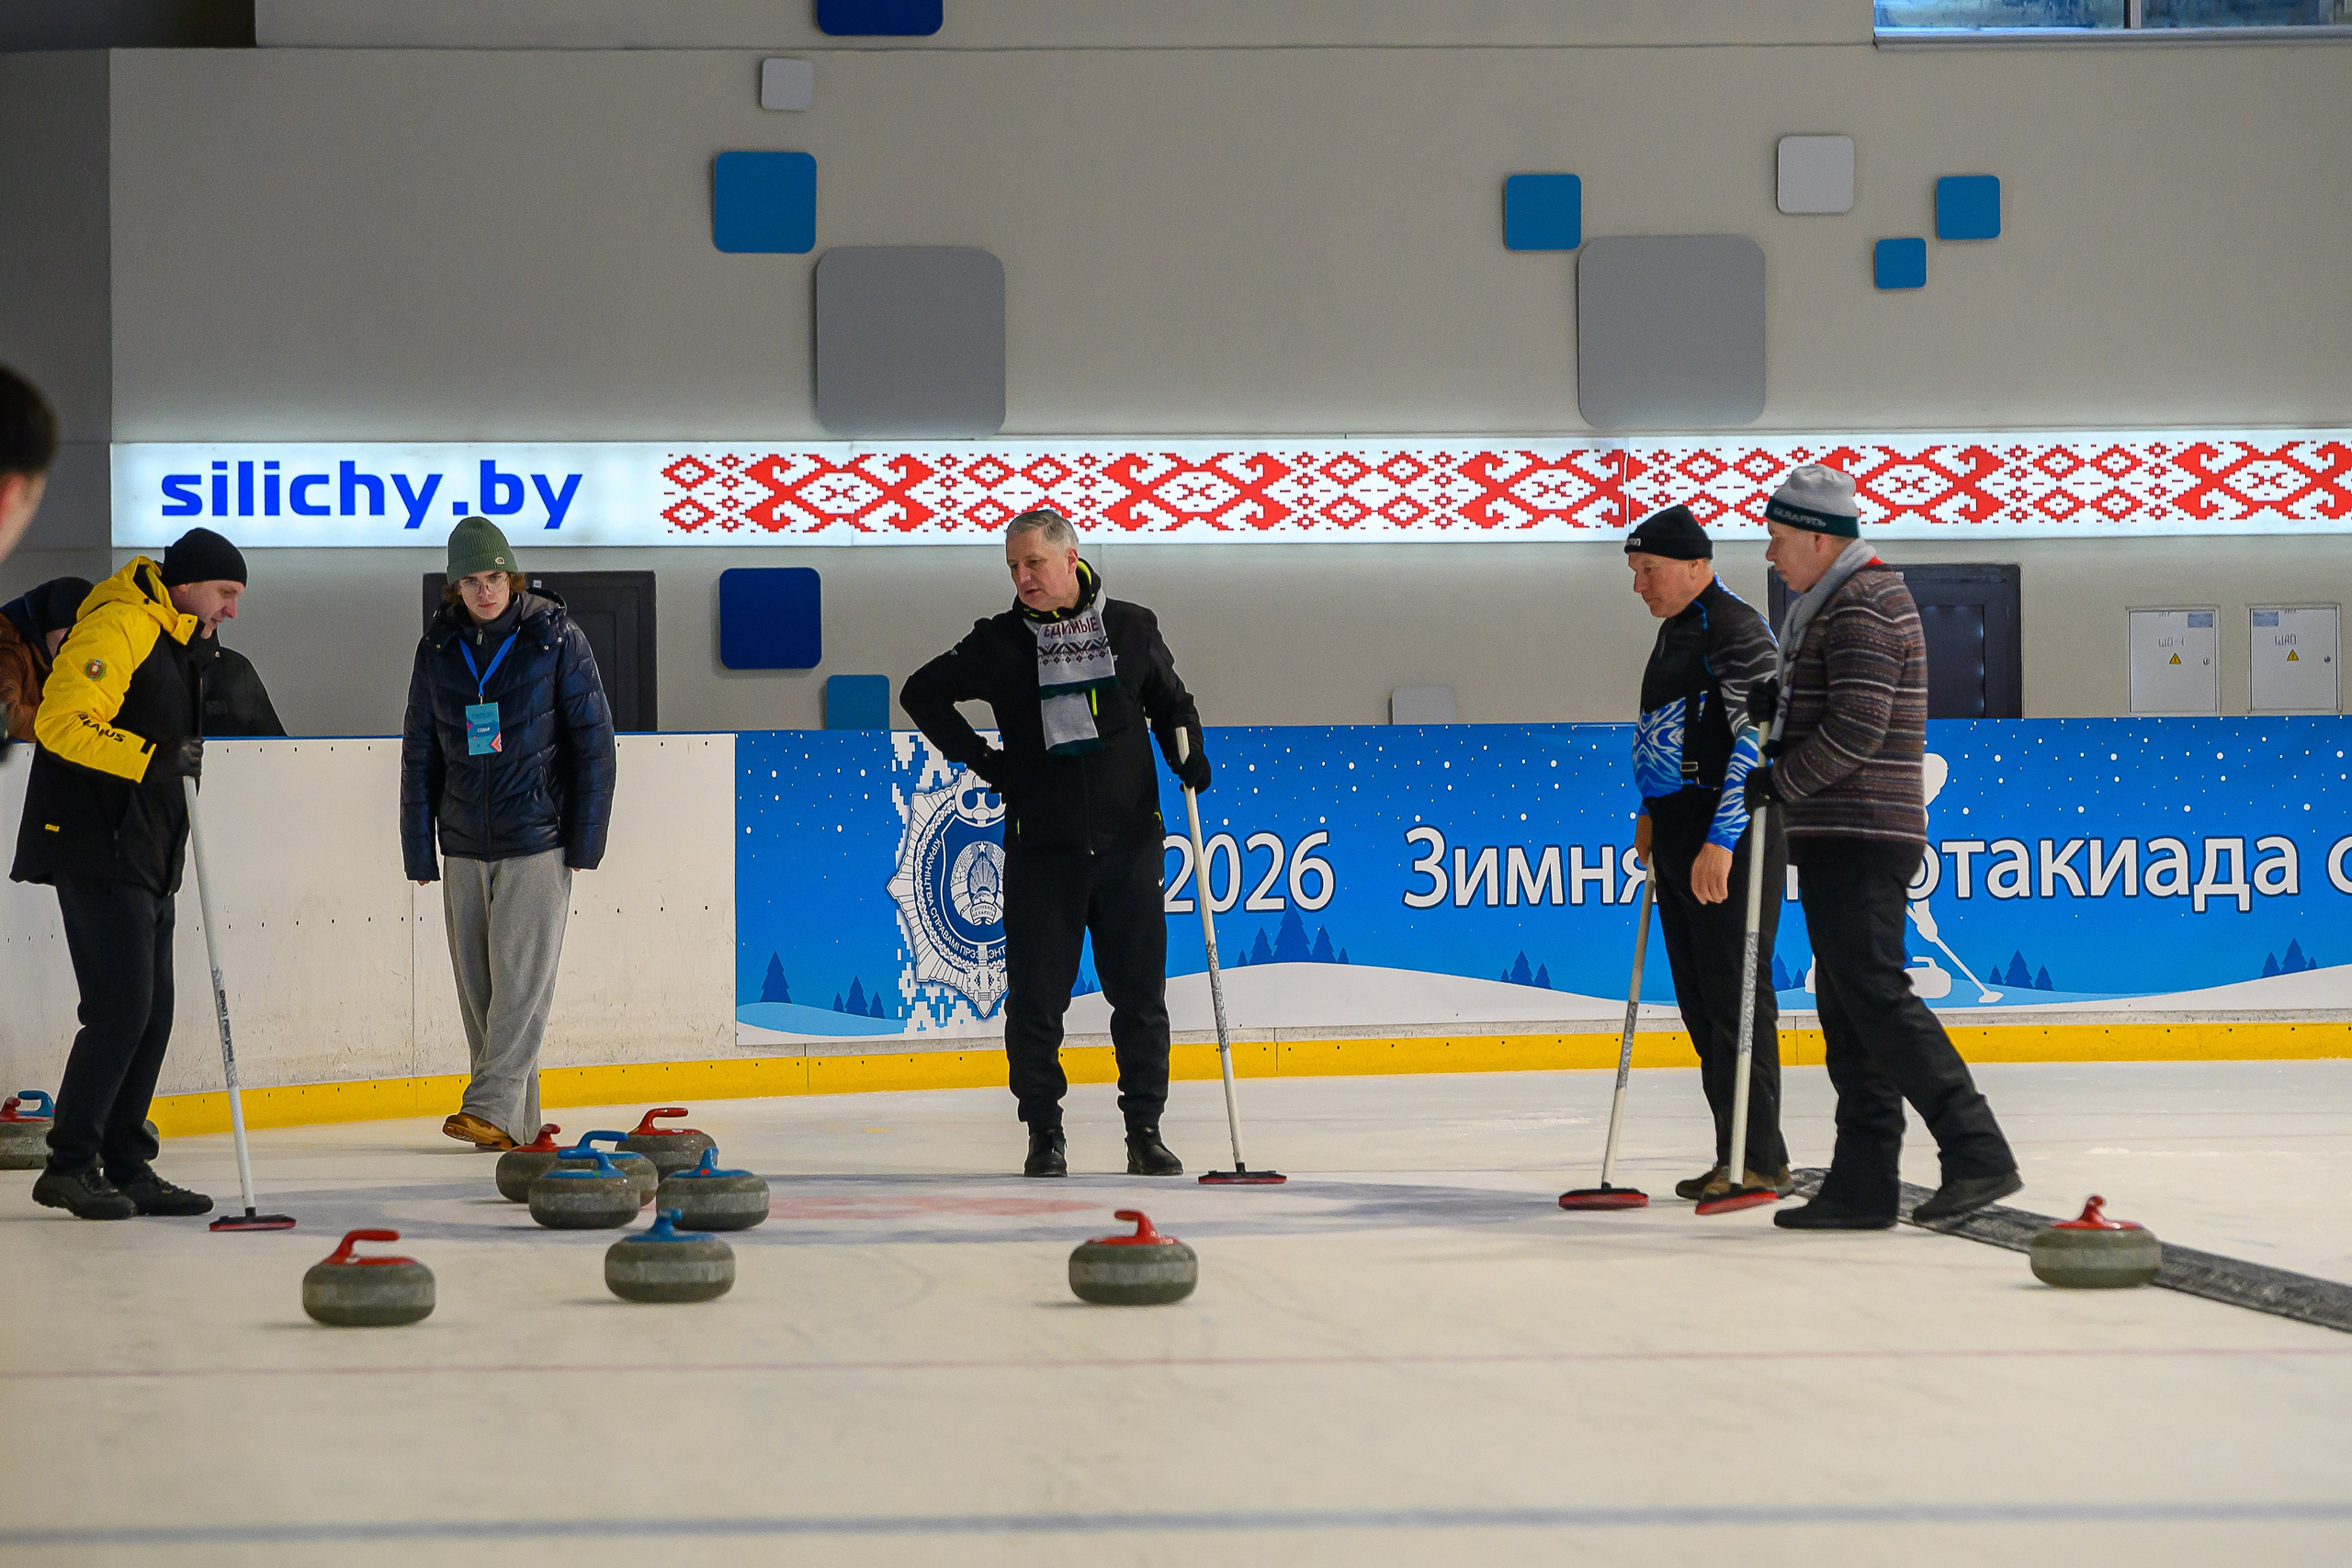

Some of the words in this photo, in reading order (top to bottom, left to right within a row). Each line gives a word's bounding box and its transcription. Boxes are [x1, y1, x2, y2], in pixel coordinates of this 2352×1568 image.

[162, 459, 583, 529] silichy.by
[1044, 615, 1099, 638] ЕДИНЫЕ
[1163, 830, 1334, 913] 2026
[1403, 826, 1657, 908] Зимня
[930, 907, 960, 952] СПРАВАМІ
